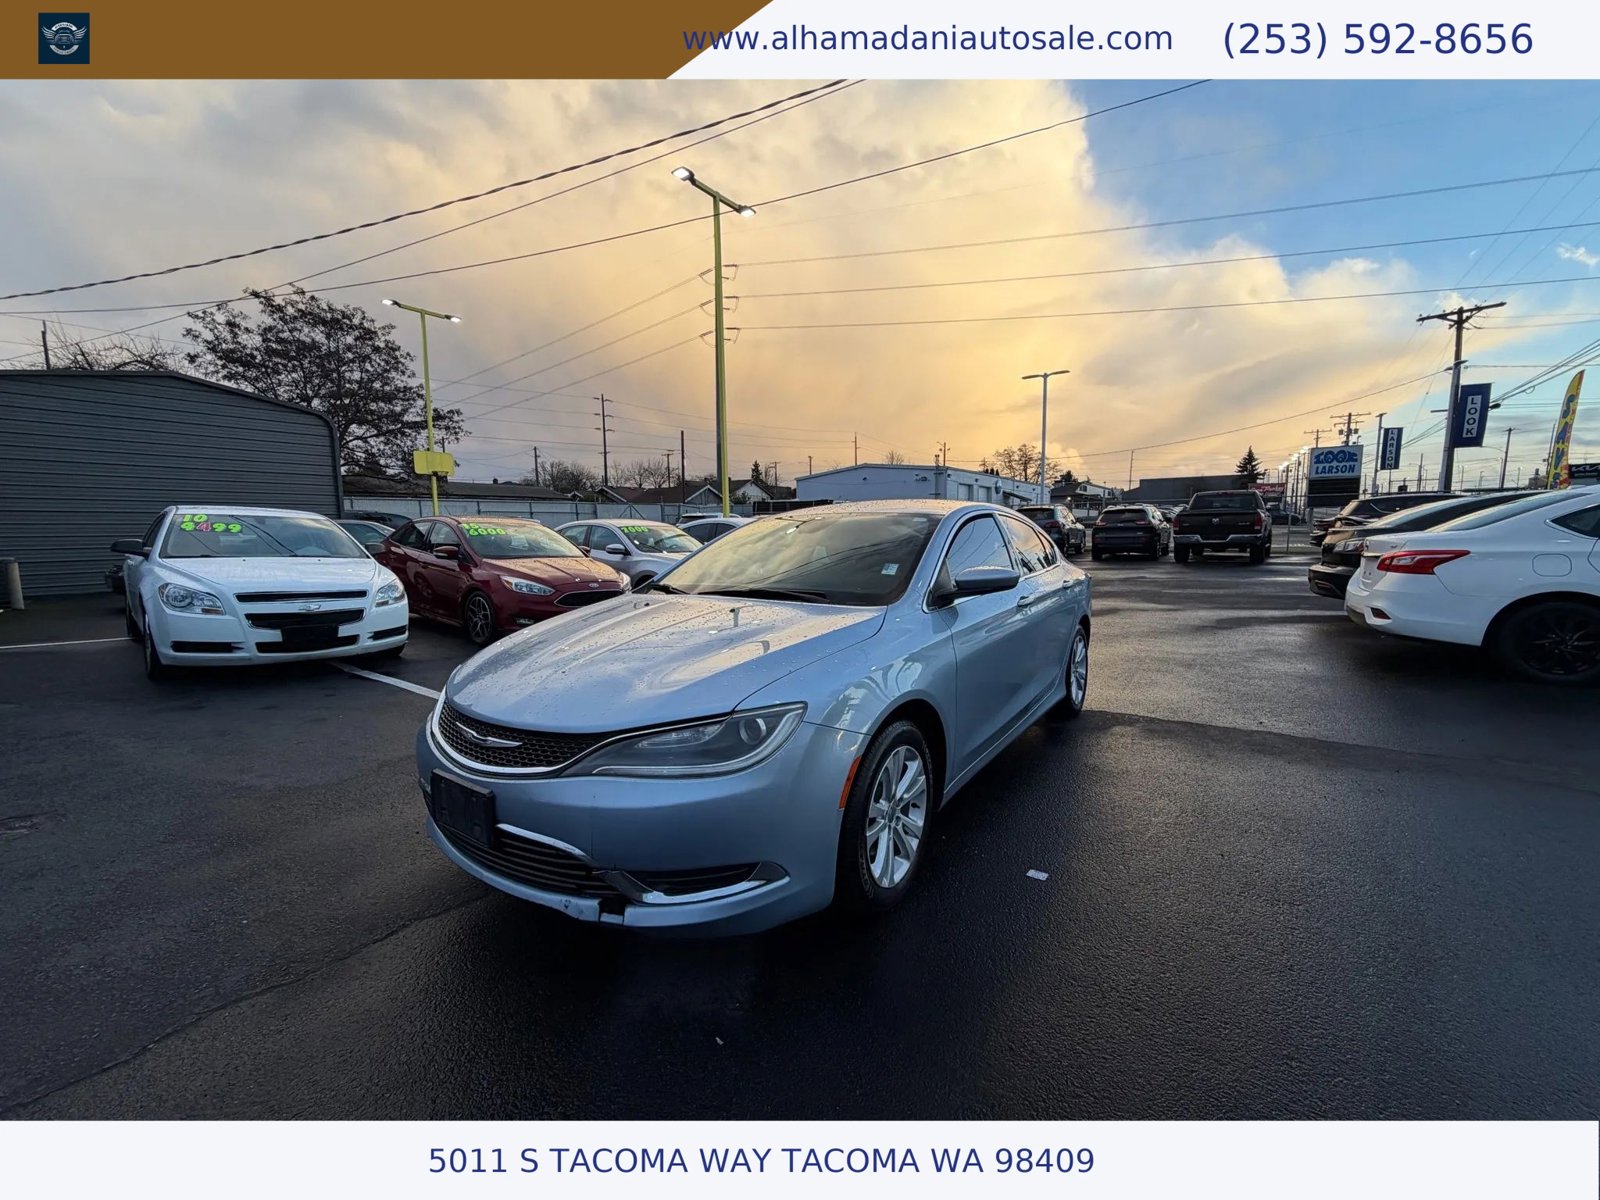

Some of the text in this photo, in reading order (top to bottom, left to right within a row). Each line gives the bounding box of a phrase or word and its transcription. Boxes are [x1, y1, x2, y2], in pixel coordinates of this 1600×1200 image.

[1465, 396, 1478, 436] LOOK
[1386, 429, 1397, 469] LARSON
[1314, 464, 1356, 475] LARSON
[469, 527, 506, 536] 6000
